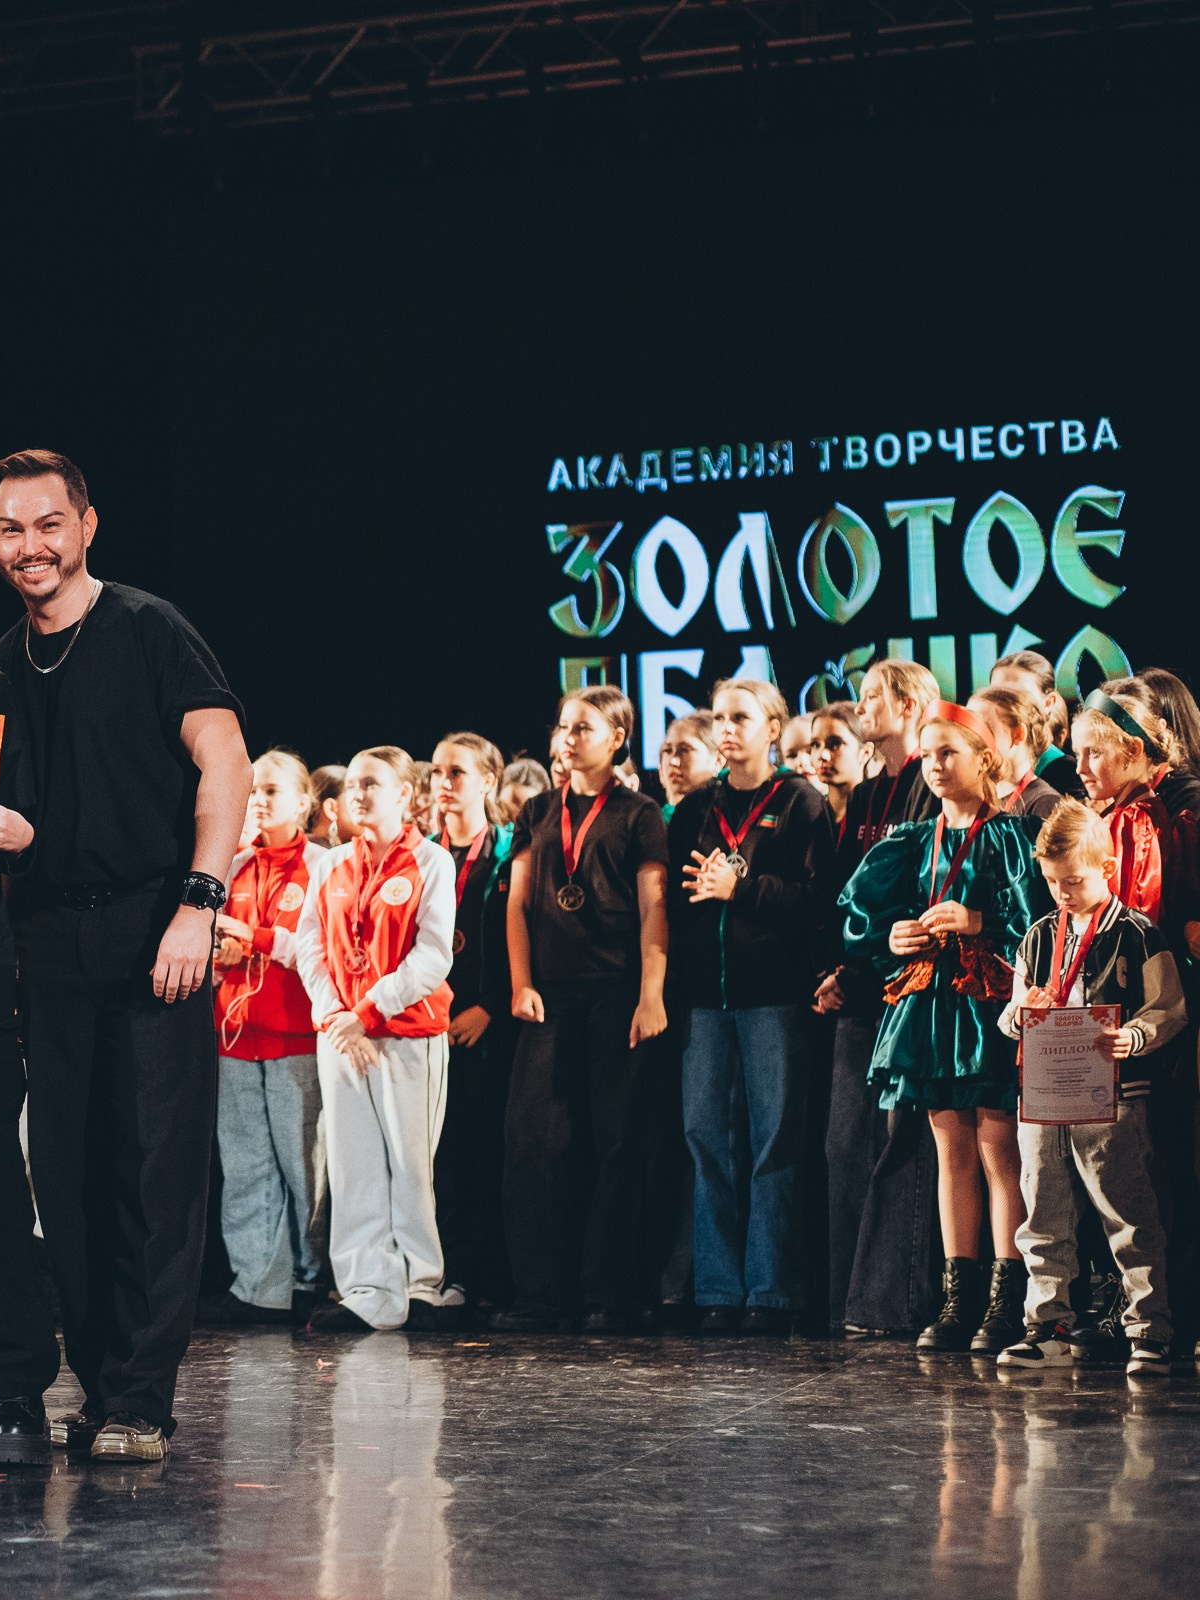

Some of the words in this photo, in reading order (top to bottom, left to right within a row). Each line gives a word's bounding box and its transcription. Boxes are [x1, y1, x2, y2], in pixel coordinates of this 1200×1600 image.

[546, 440, 794, 493] АКАДЕМИЯ
[809, 416, 1121, 473] ТВОРЧЕСТВА
[546, 484, 1126, 639] ЗОЛОТОЕ
[1040, 1045, 1096, 1055] ДИПЛОМ
